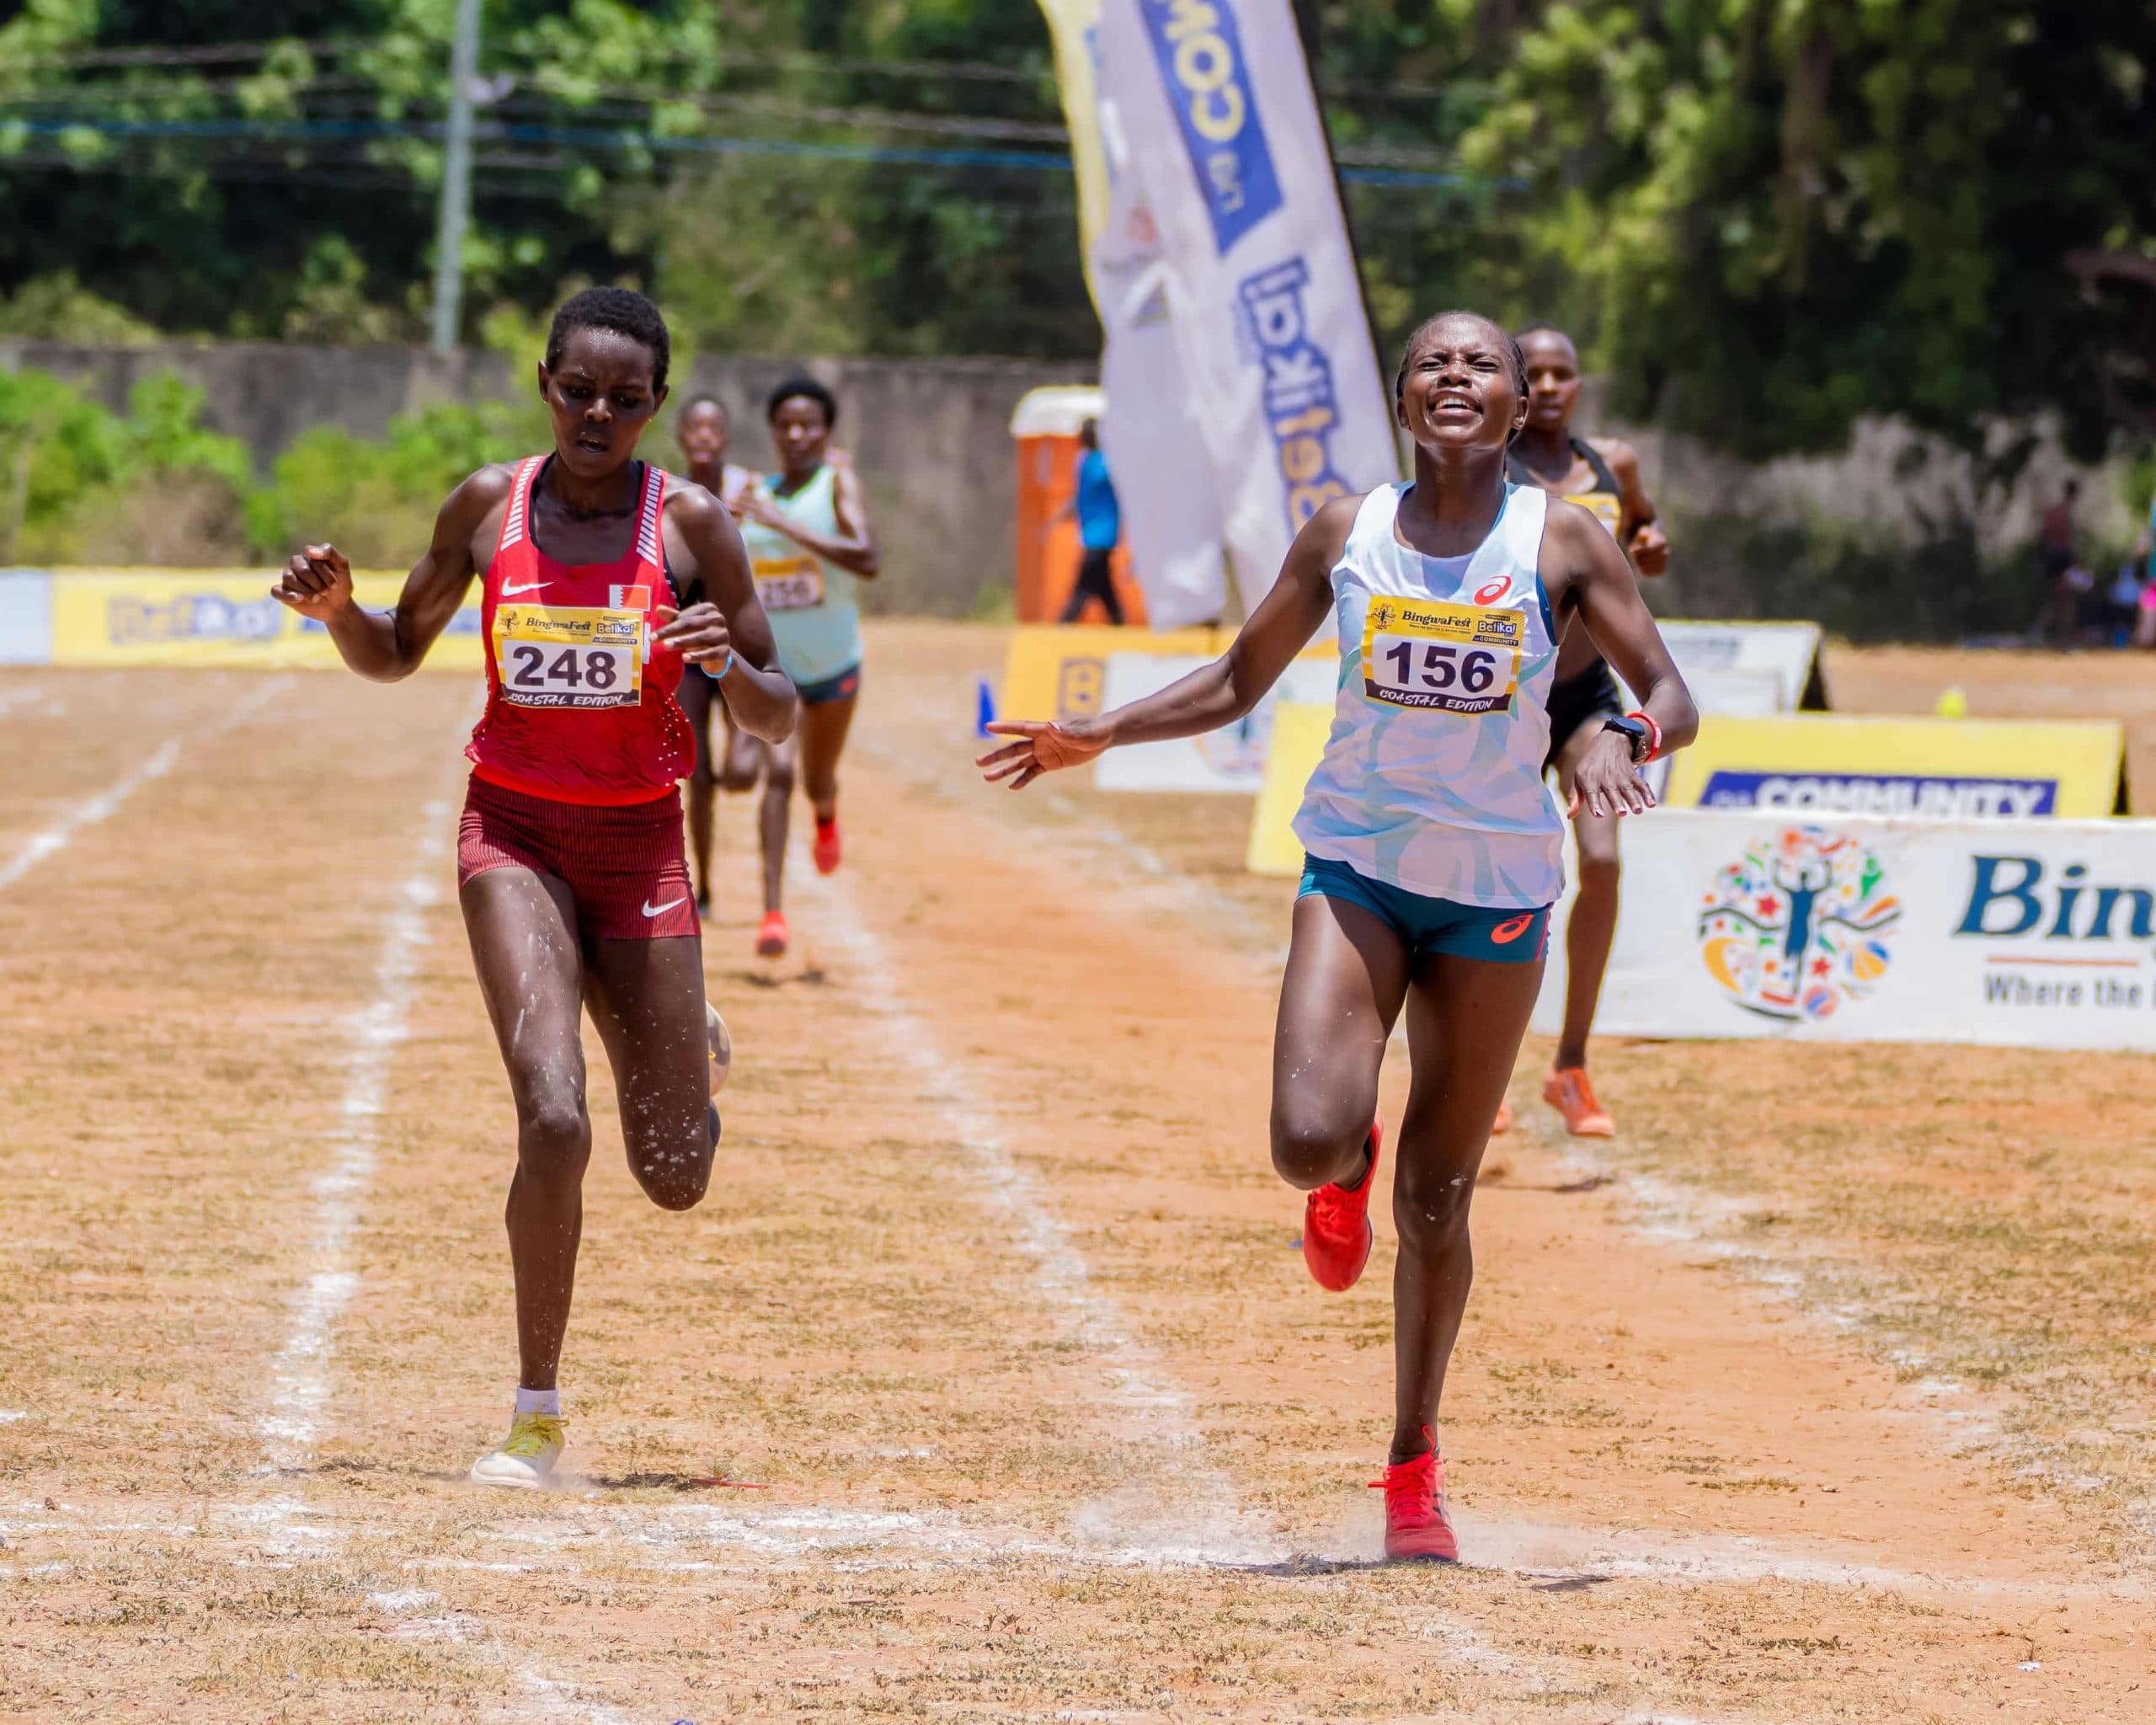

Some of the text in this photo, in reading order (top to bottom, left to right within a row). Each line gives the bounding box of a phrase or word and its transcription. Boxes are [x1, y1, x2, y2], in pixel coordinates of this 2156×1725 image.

[526, 617, 591, 631] BingwaFest
[1401, 611, 1470, 627] BingwaFest
[512, 645, 616, 690] 248
[1386, 641, 1496, 693] 156
[509, 693, 622, 707] COASTAL EDITION
[1380, 689, 1493, 713] COASTAL EDITION
[1757, 777, 2045, 817] COMMUNITY
[1984, 973, 2143, 1007] Where the
